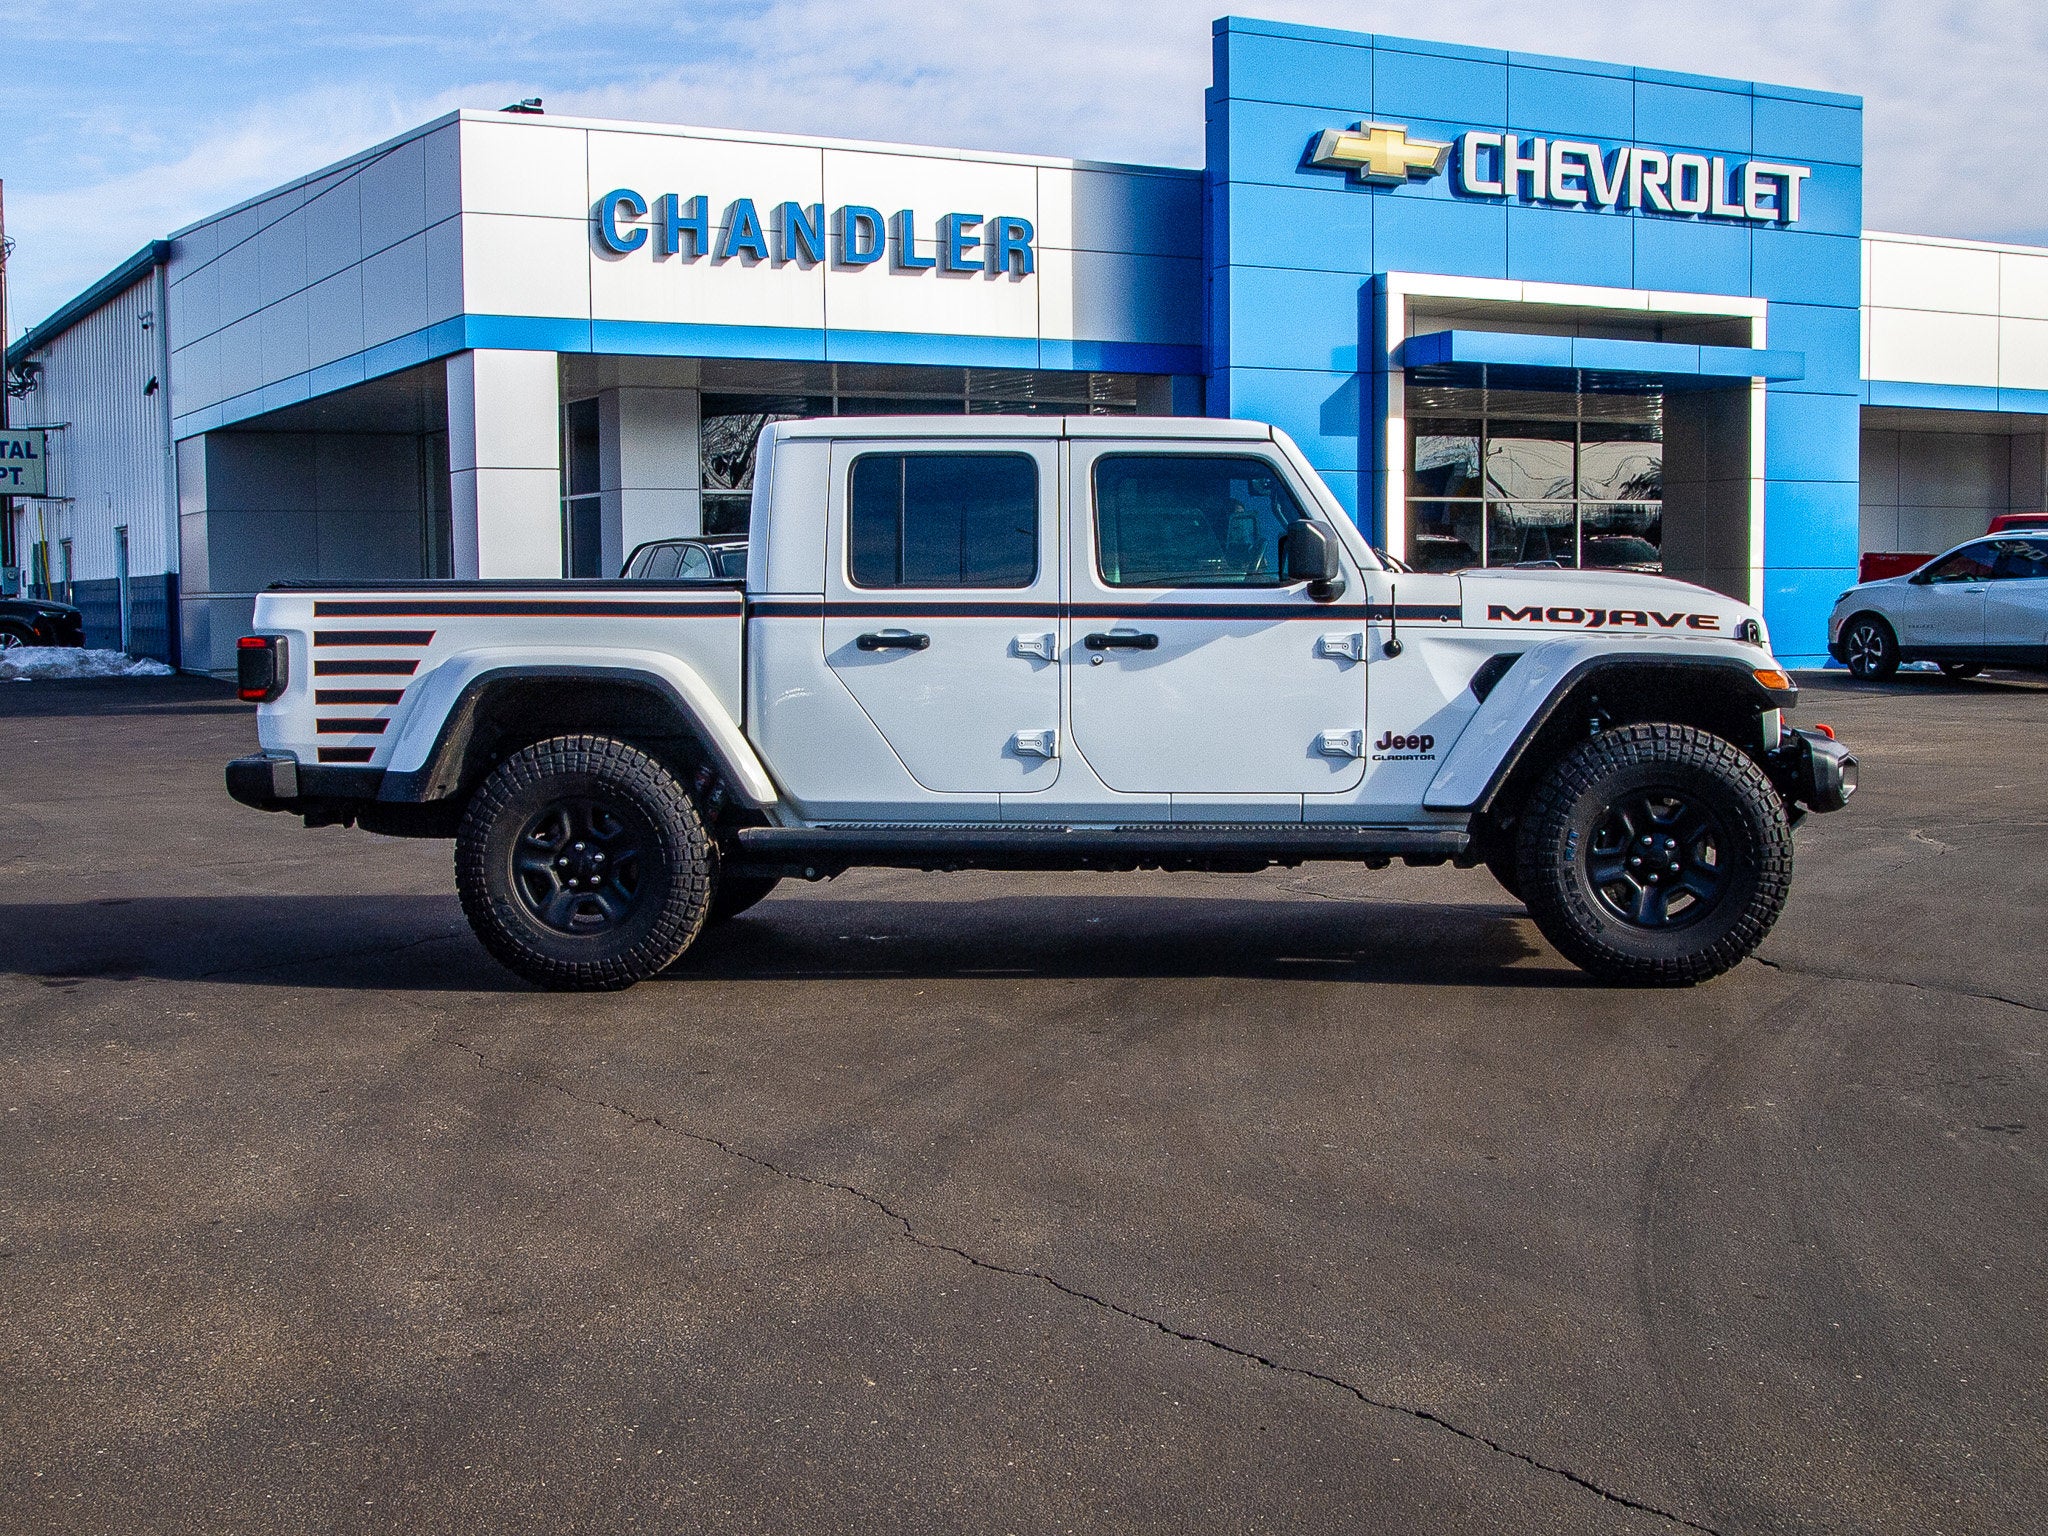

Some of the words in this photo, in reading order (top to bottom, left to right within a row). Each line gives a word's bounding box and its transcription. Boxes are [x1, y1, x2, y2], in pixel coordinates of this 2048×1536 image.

[1459, 131, 1811, 223] CHEVROLET
[594, 188, 1036, 280] CHANDLER
[0, 440, 38, 459] TAL
[1487, 604, 1720, 631] MOJAVE
[1375, 730, 1435, 753] Jeep
